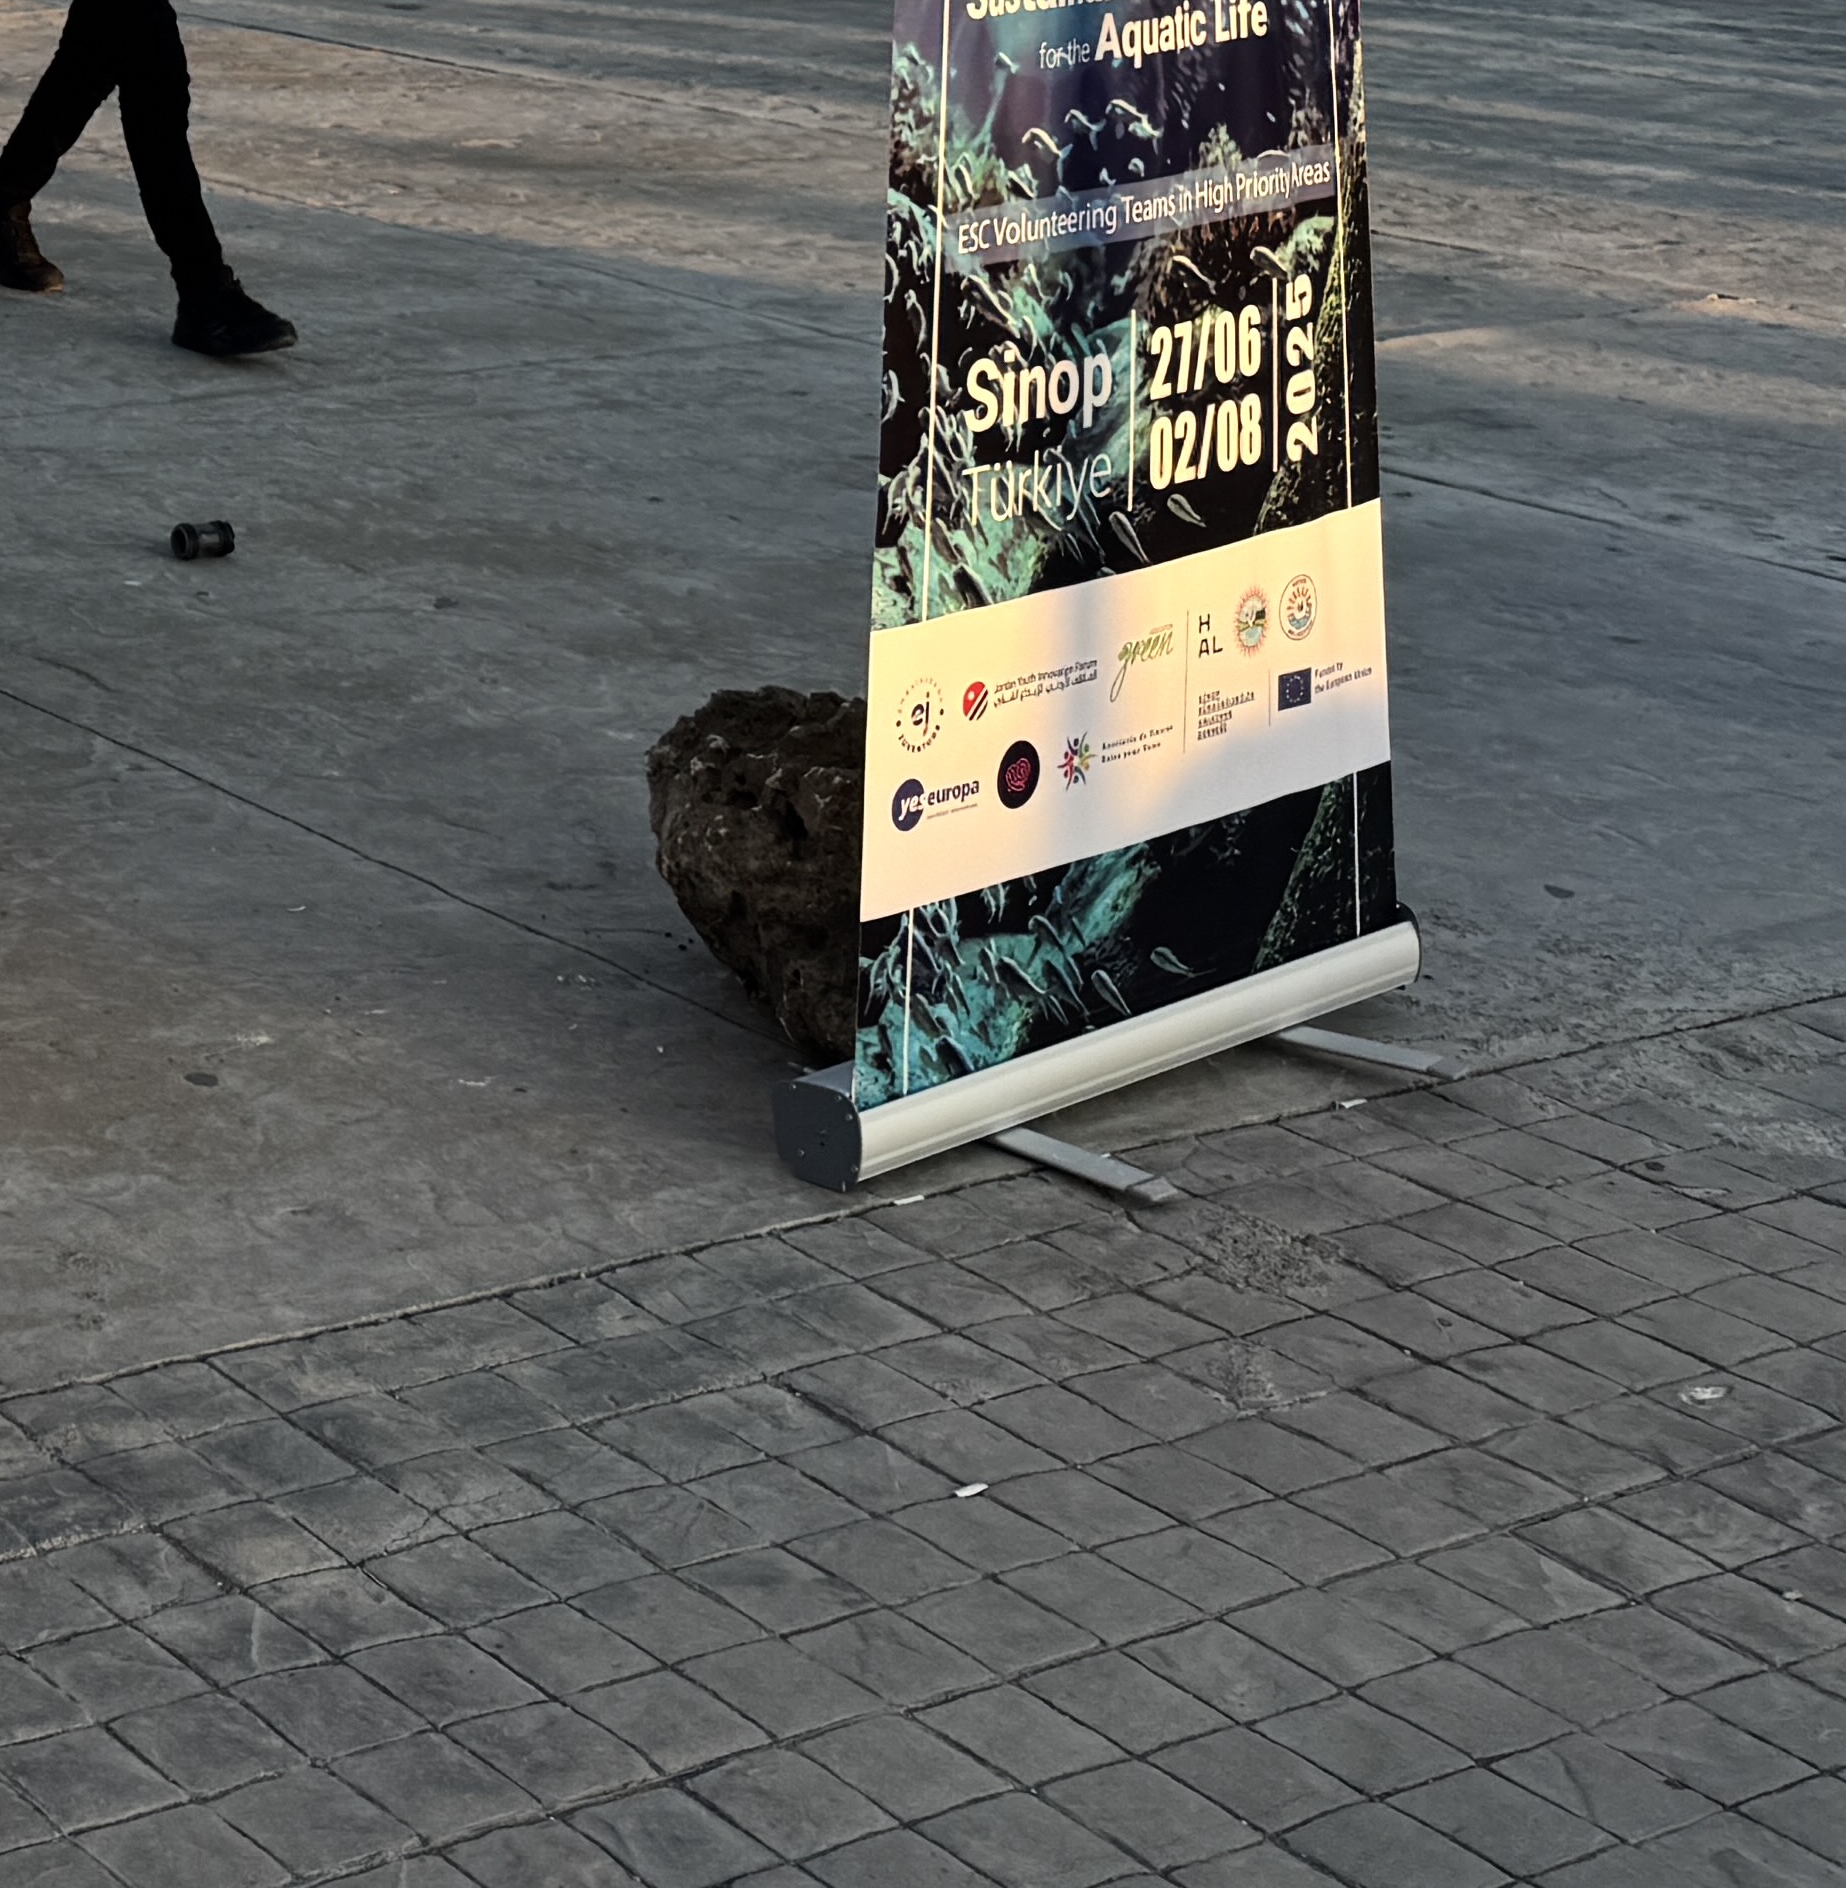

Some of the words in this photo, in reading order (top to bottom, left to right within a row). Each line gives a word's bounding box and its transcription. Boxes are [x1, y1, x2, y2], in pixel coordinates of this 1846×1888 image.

[1038, 41, 1067, 70] for
[1067, 37, 1091, 66] the
[1094, 0, 1208, 69] Aquatic
[957, 219, 991, 255] ESC
[992, 203, 1118, 245] Volunteering
[1120, 193, 1177, 225] Teams
[1178, 185, 1193, 213] in
[1194, 177, 1234, 215] High
[1236, 166, 1291, 203] Priority
[1291, 160, 1331, 189] Areas
[964, 348, 1113, 434] Sinop
[1149, 304, 1262, 401] 27/06
[1284, 273, 1319, 463] 2025
[1148, 392, 1263, 491] 02/08
[961, 445, 1113, 529] Türkiye
[1109, 629, 1175, 703] green
